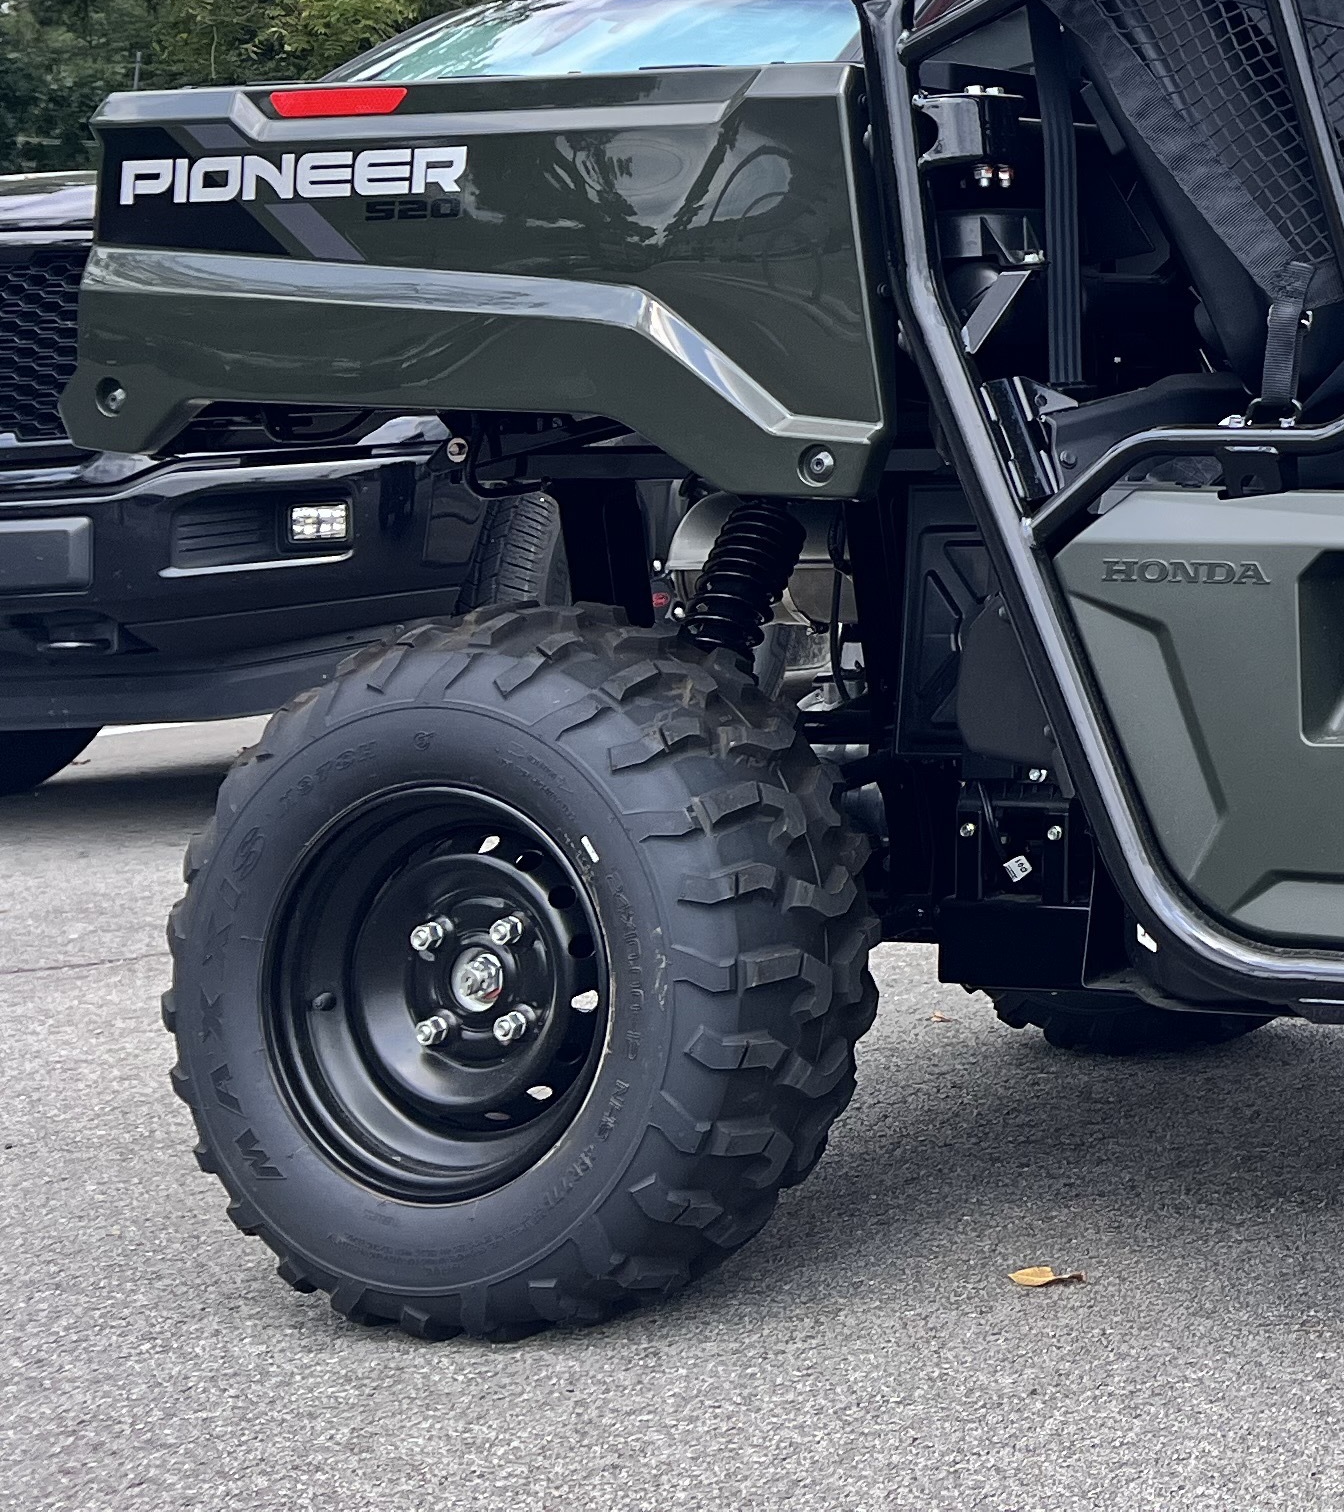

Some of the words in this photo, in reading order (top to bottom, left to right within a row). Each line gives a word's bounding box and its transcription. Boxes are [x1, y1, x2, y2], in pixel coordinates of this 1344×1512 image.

[119, 145, 468, 205] PIONEER
[364, 197, 462, 222] 520
[1101, 558, 1272, 586] HONDA
[198, 825, 288, 1180] MAXXIS
